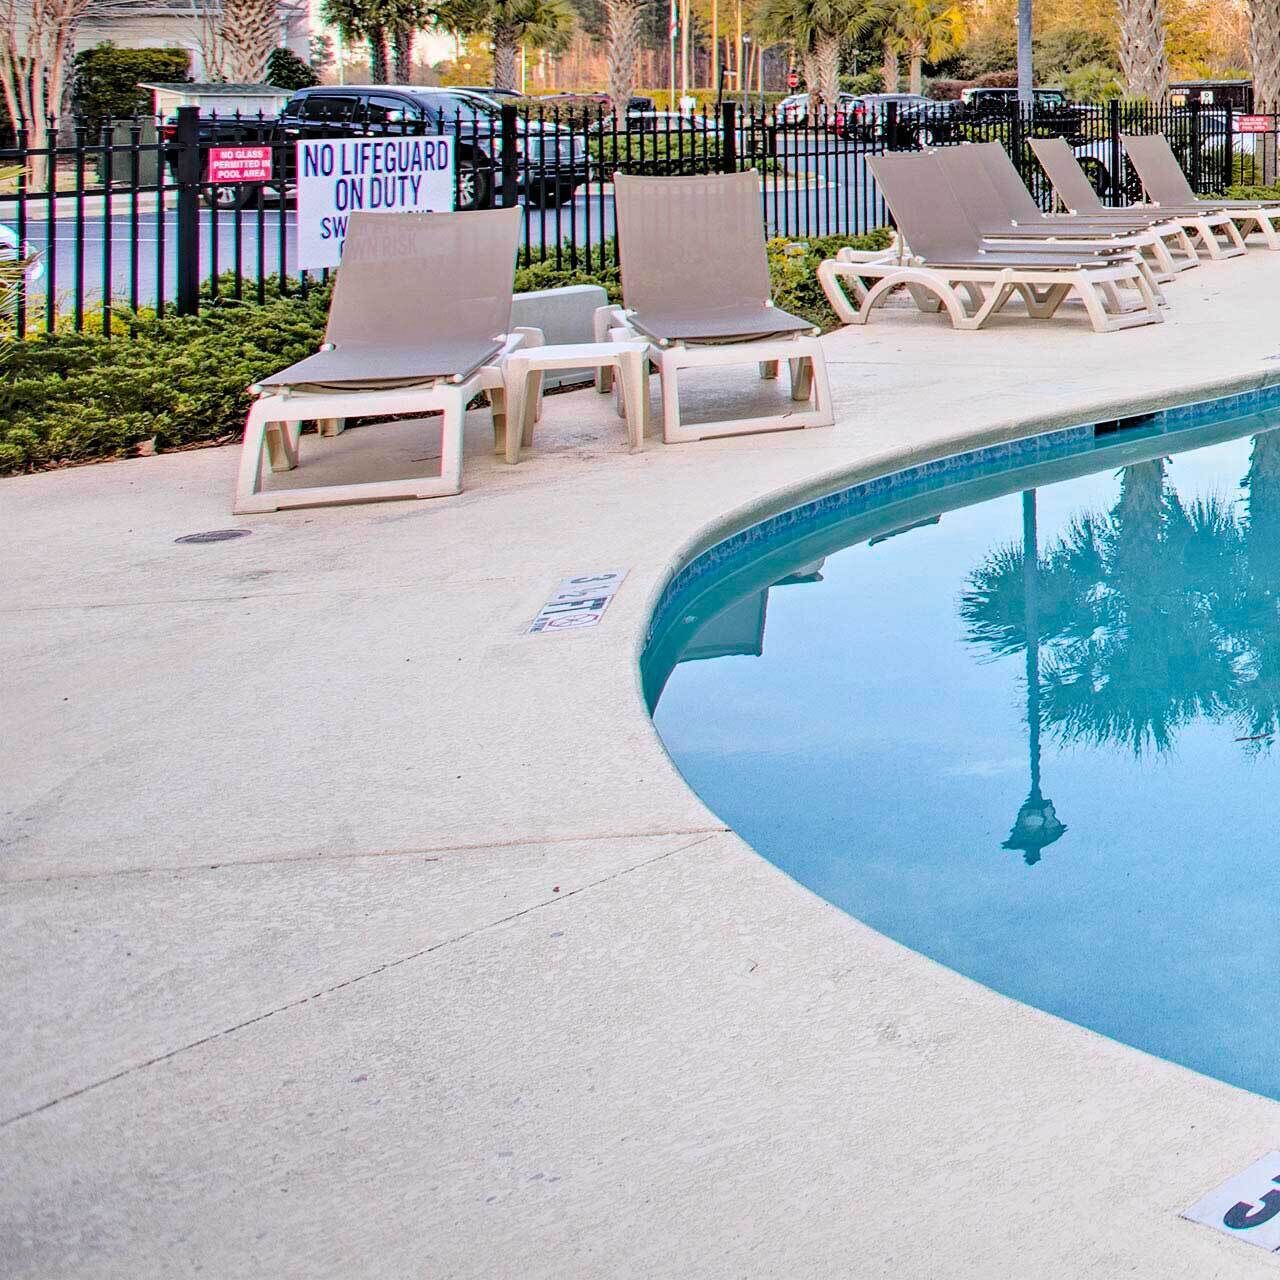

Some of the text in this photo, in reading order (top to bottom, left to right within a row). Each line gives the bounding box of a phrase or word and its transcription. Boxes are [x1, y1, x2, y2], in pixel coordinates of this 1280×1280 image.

[221, 149, 264, 159] NO GLASS
[303, 140, 449, 177] NO LIFEGUARD
[213, 160, 261, 169] PERMITTED
[217, 169, 266, 179] POOL AREA
[335, 174, 421, 211] ON DUTY
